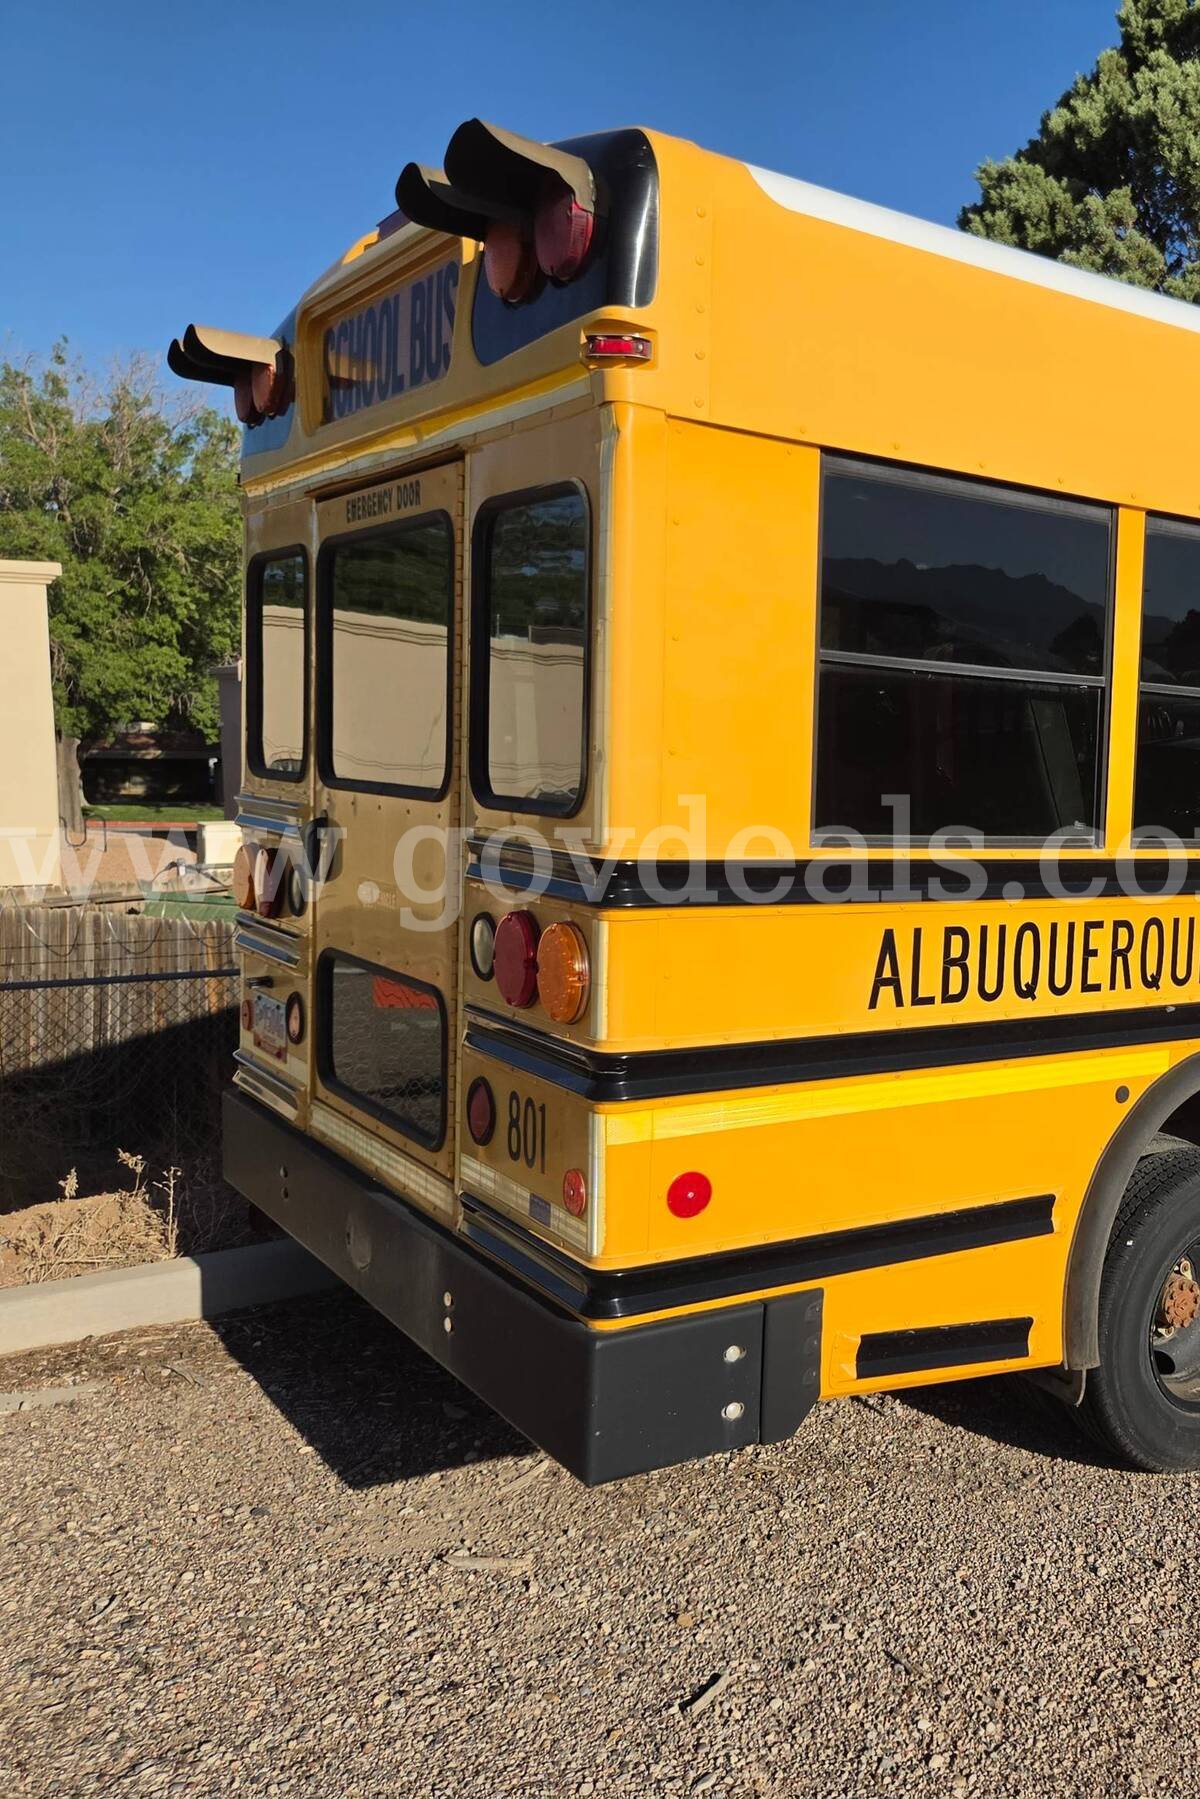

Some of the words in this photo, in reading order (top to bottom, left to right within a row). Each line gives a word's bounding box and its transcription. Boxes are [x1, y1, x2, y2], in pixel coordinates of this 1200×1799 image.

[410, 261, 459, 387] BUS
[346, 487, 393, 523] EMERGENCY
[397, 480, 421, 510] DOOR
[508, 1090, 546, 1174] 801
